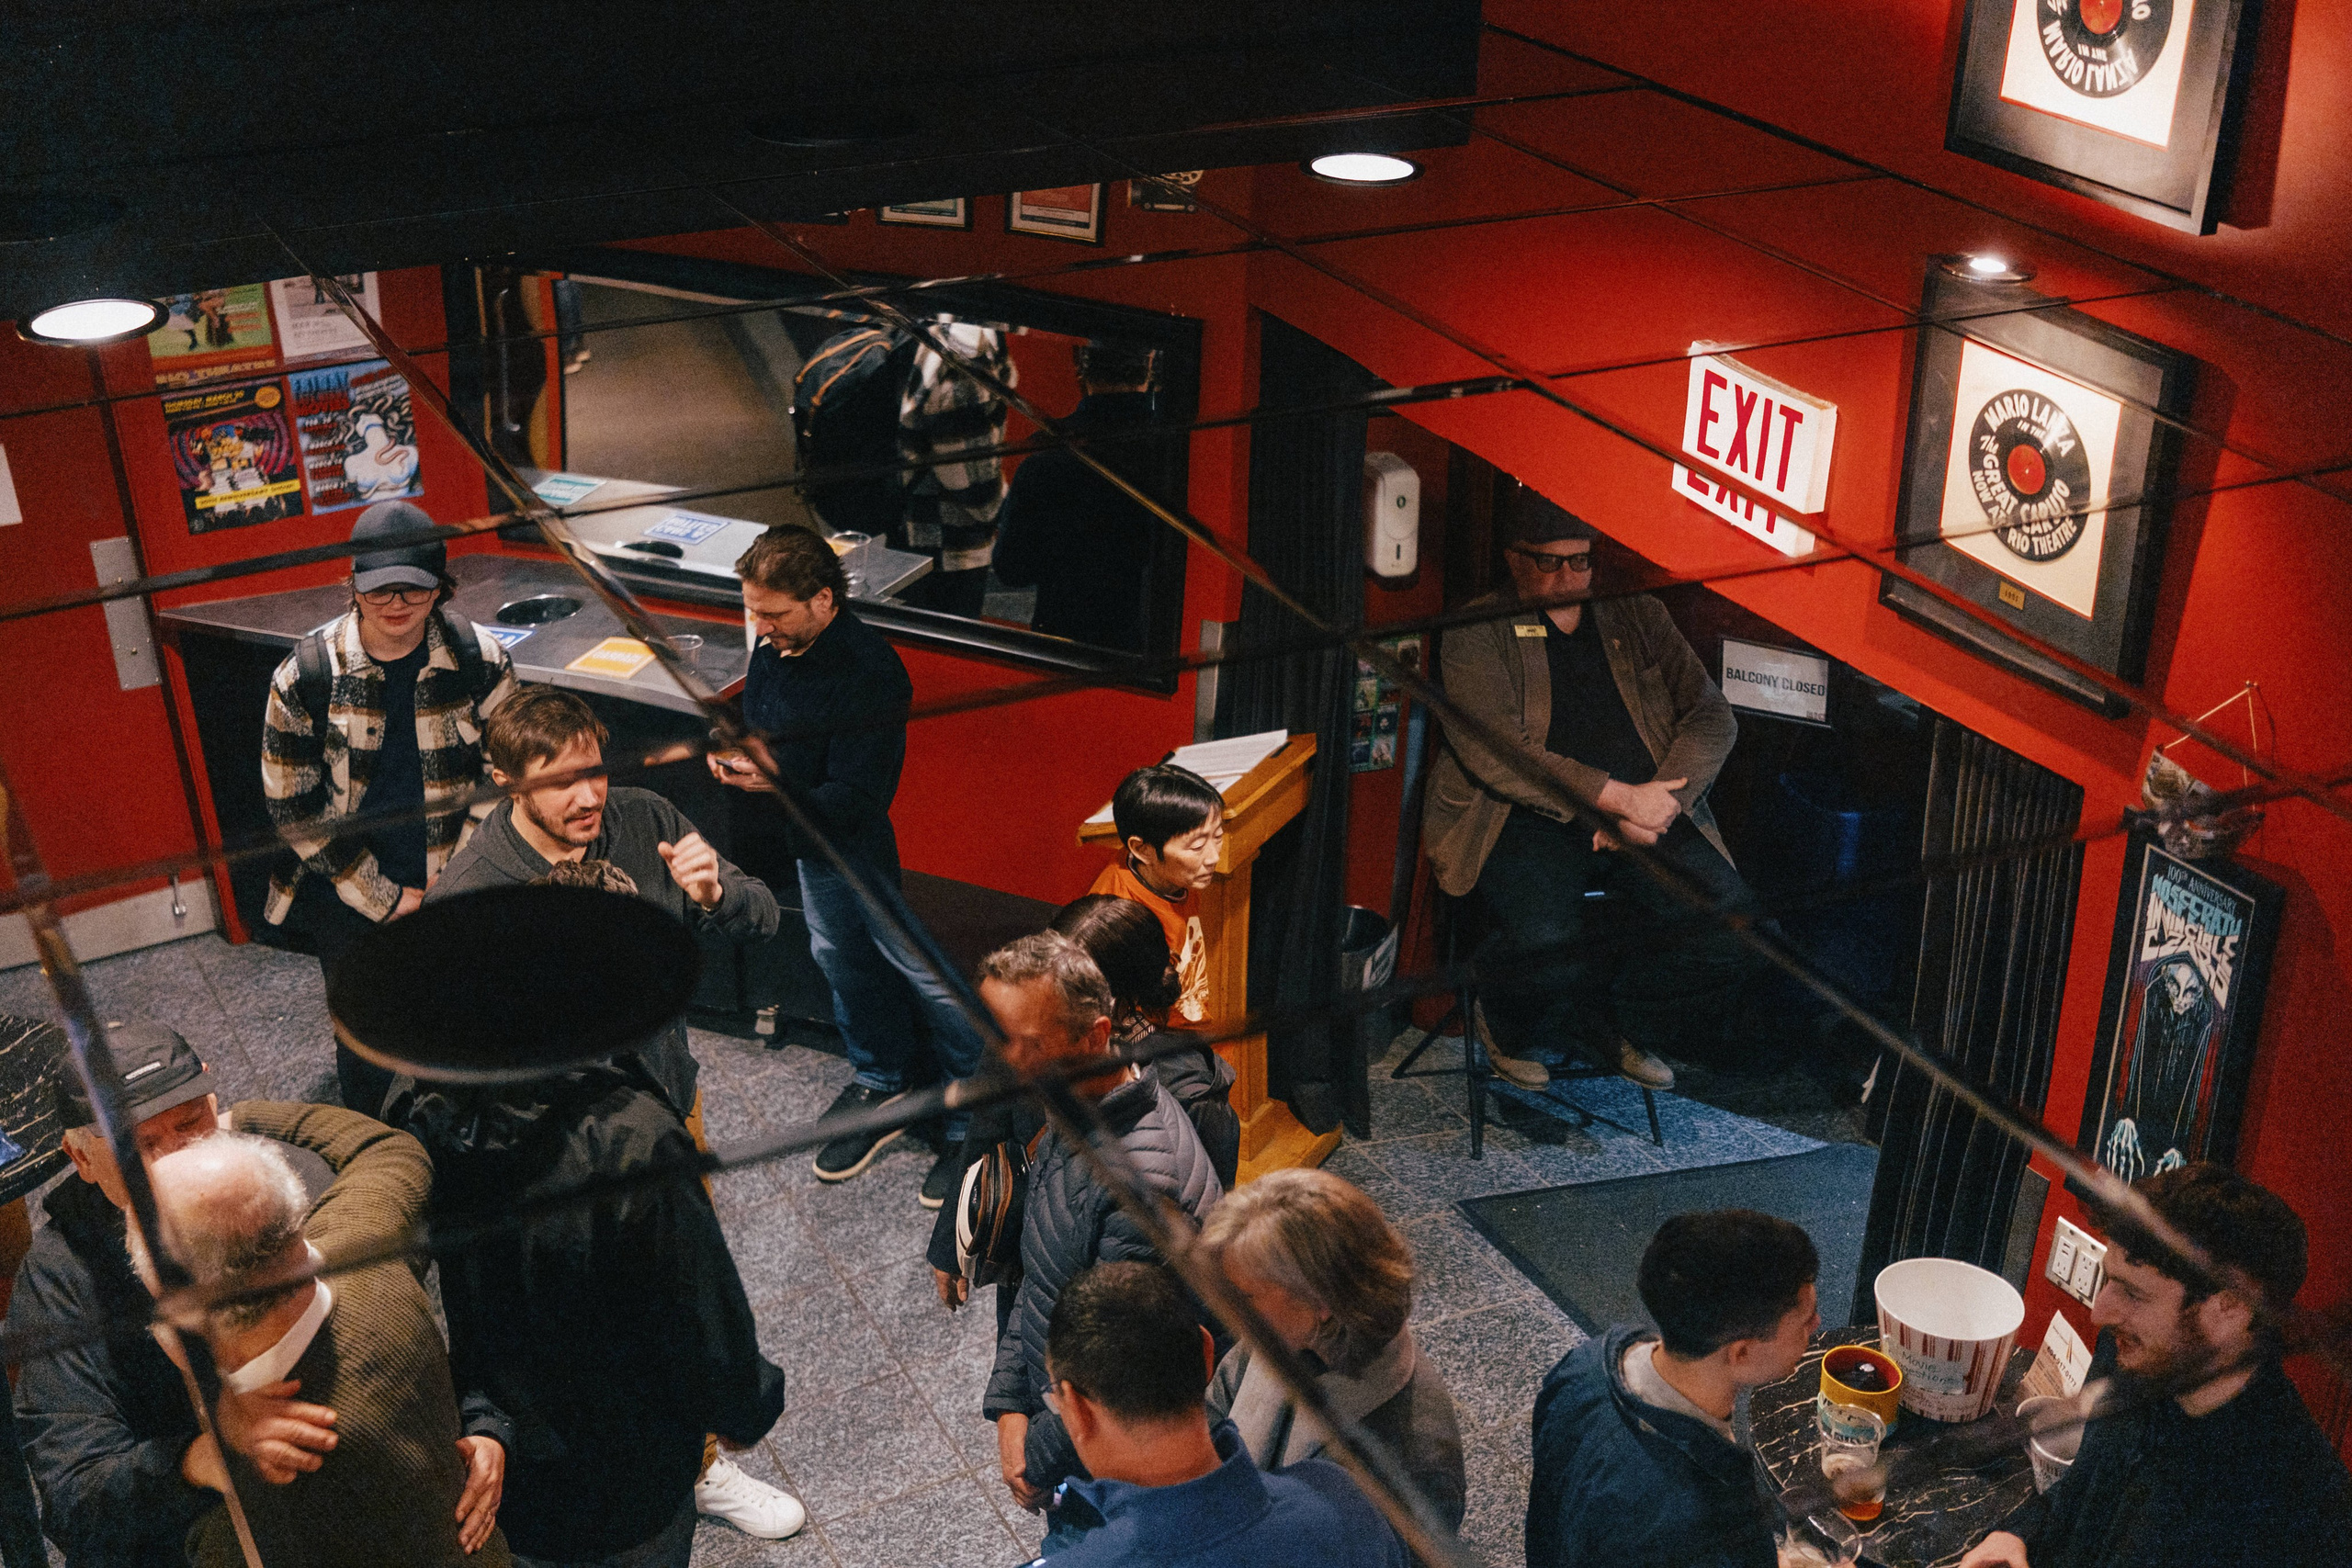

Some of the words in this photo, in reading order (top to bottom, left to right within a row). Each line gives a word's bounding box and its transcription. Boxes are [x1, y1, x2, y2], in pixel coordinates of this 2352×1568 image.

[1697, 368, 1804, 492] EXIT
[1984, 393, 2030, 433] MARIO
[2017, 420, 2030, 433] IN
[1984, 454, 2019, 514] GREAT
[1972, 470, 1994, 503] NOW
[2007, 527, 2030, 553] RIO
[2031, 515, 2077, 556] THEATRE
[1726, 667, 1779, 688] BALCONY
[1781, 677, 1826, 696] CLOSED
[2152, 873, 2242, 937] NOSFERATU
[2188, 877, 2238, 916] ANNIVERSARY
[2145, 891, 2239, 958] INVINCIBLE
[1902, 1351, 1937, 1373] Movie
